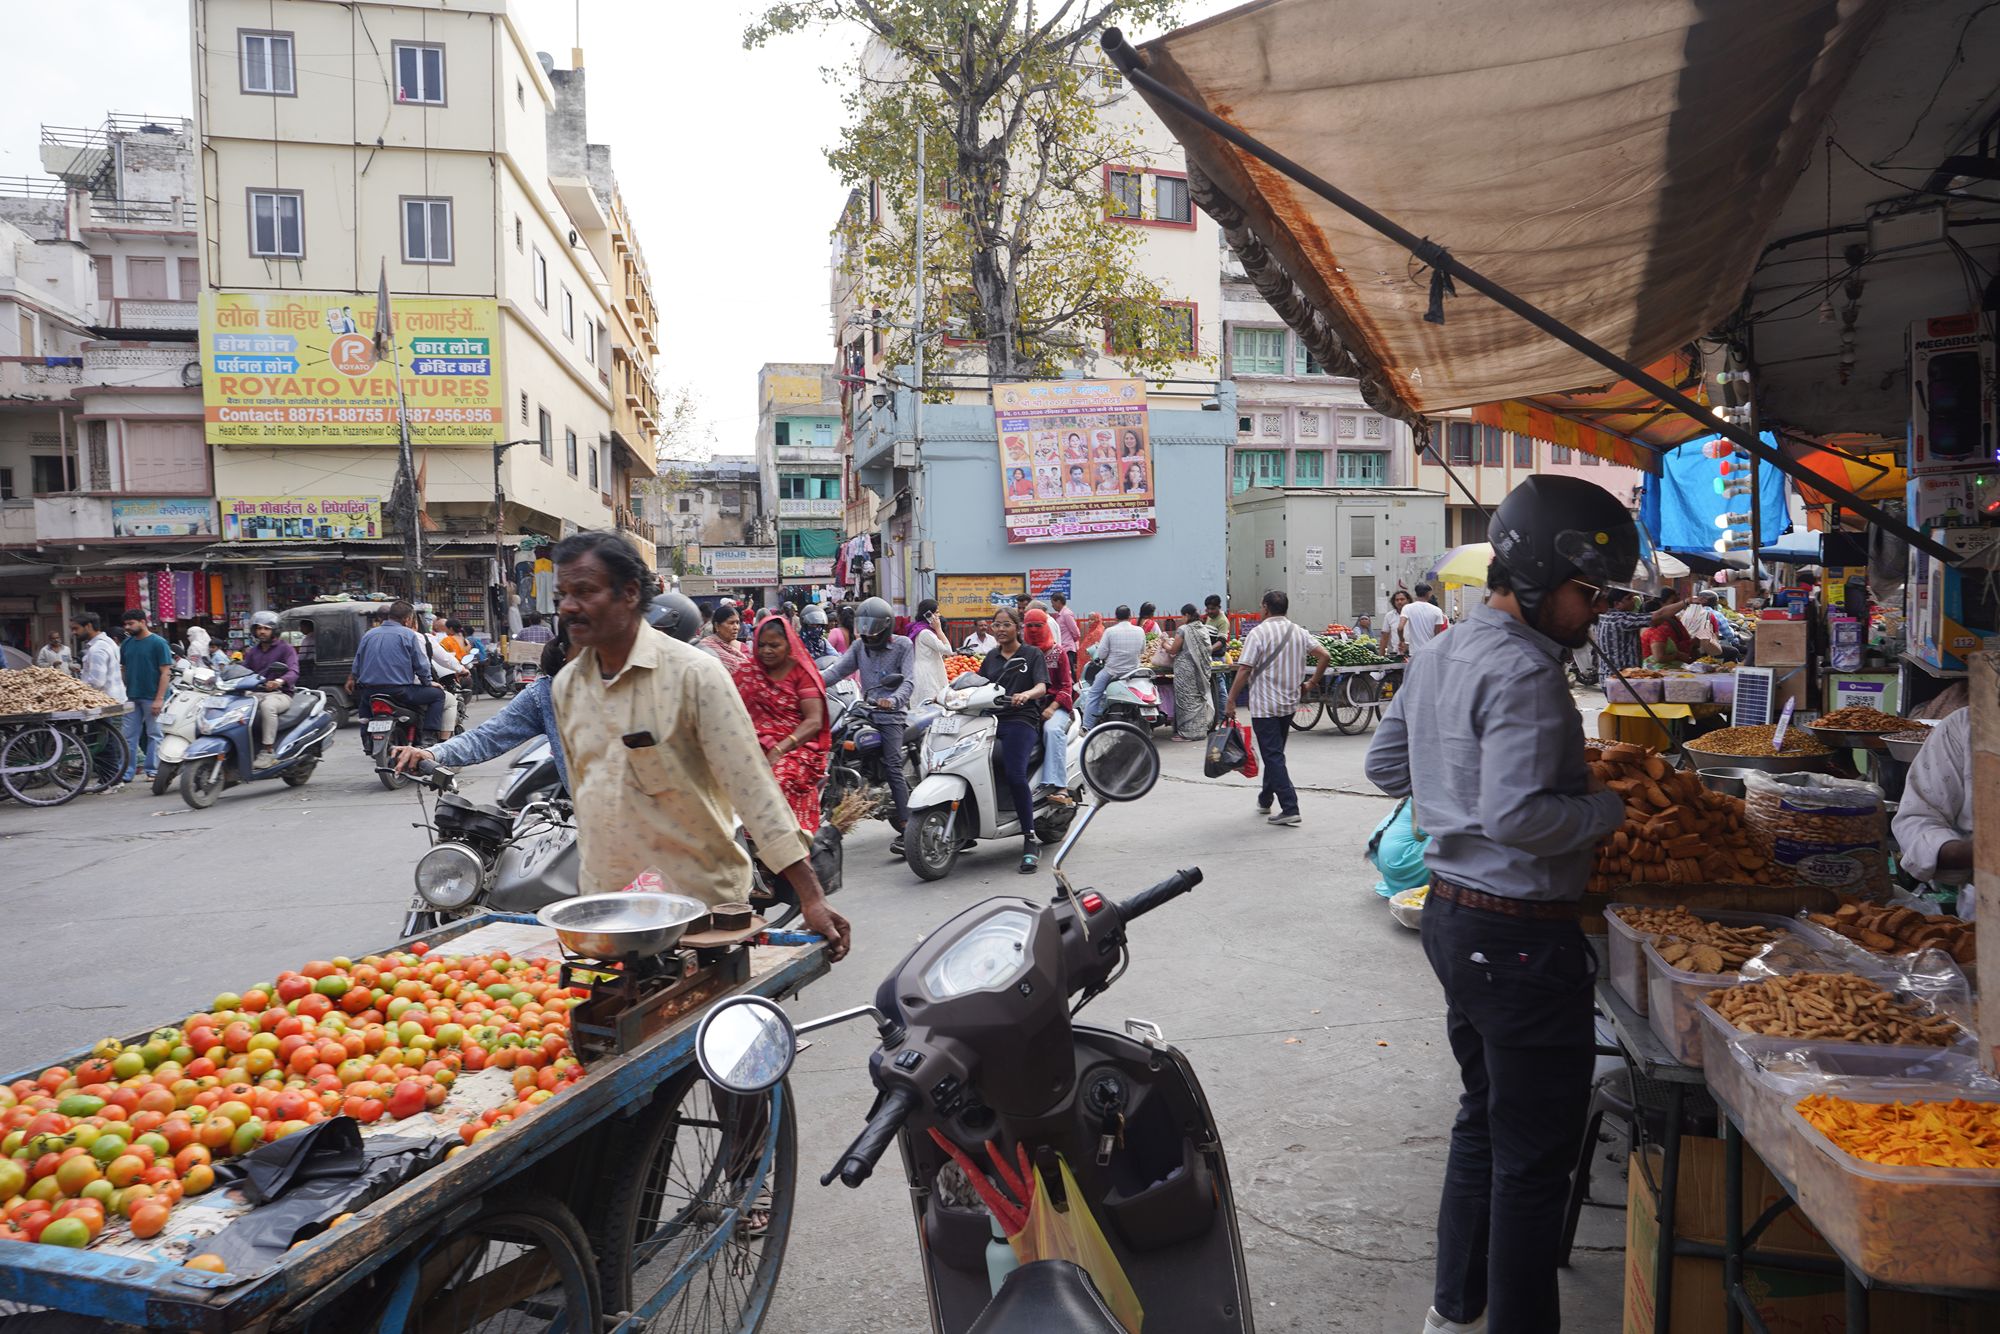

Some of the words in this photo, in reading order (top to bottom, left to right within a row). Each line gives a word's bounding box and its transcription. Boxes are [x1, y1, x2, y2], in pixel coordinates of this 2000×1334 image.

[216, 303, 259, 328] लोन
[265, 303, 321, 330] चाहिए
[217, 335, 250, 351] होम
[254, 336, 291, 352] लोन
[415, 341, 447, 354] कार
[448, 338, 483, 354] लोन
[217, 357, 262, 373] पर्सनल
[264, 357, 293, 373] लोन
[339, 363, 370, 371] ROYATO
[419, 359, 456, 375] क्रेडिट
[458, 359, 487, 374] कार्ड
[219, 376, 341, 397] ROYATO
[348, 378, 490, 398] VENTURES
[219, 408, 284, 422] Contact:
[288, 408, 383, 422] 88751-88755
[219, 426, 237, 436] Head
[264, 426, 276, 436] 2nd
[298, 426, 320, 438] Shyam
[343, 426, 384, 437] Hazareshwar
[428, 426, 446, 436] Court
[469, 426, 493, 438] Udaipur
[160, 505, 208, 515] कलेक्शन
[260, 501, 302, 514] मोबाईल
[307, 503, 317, 513] &
[715, 551, 747, 559] AHUJA
[957, 593, 983, 605] प्राथमिक
